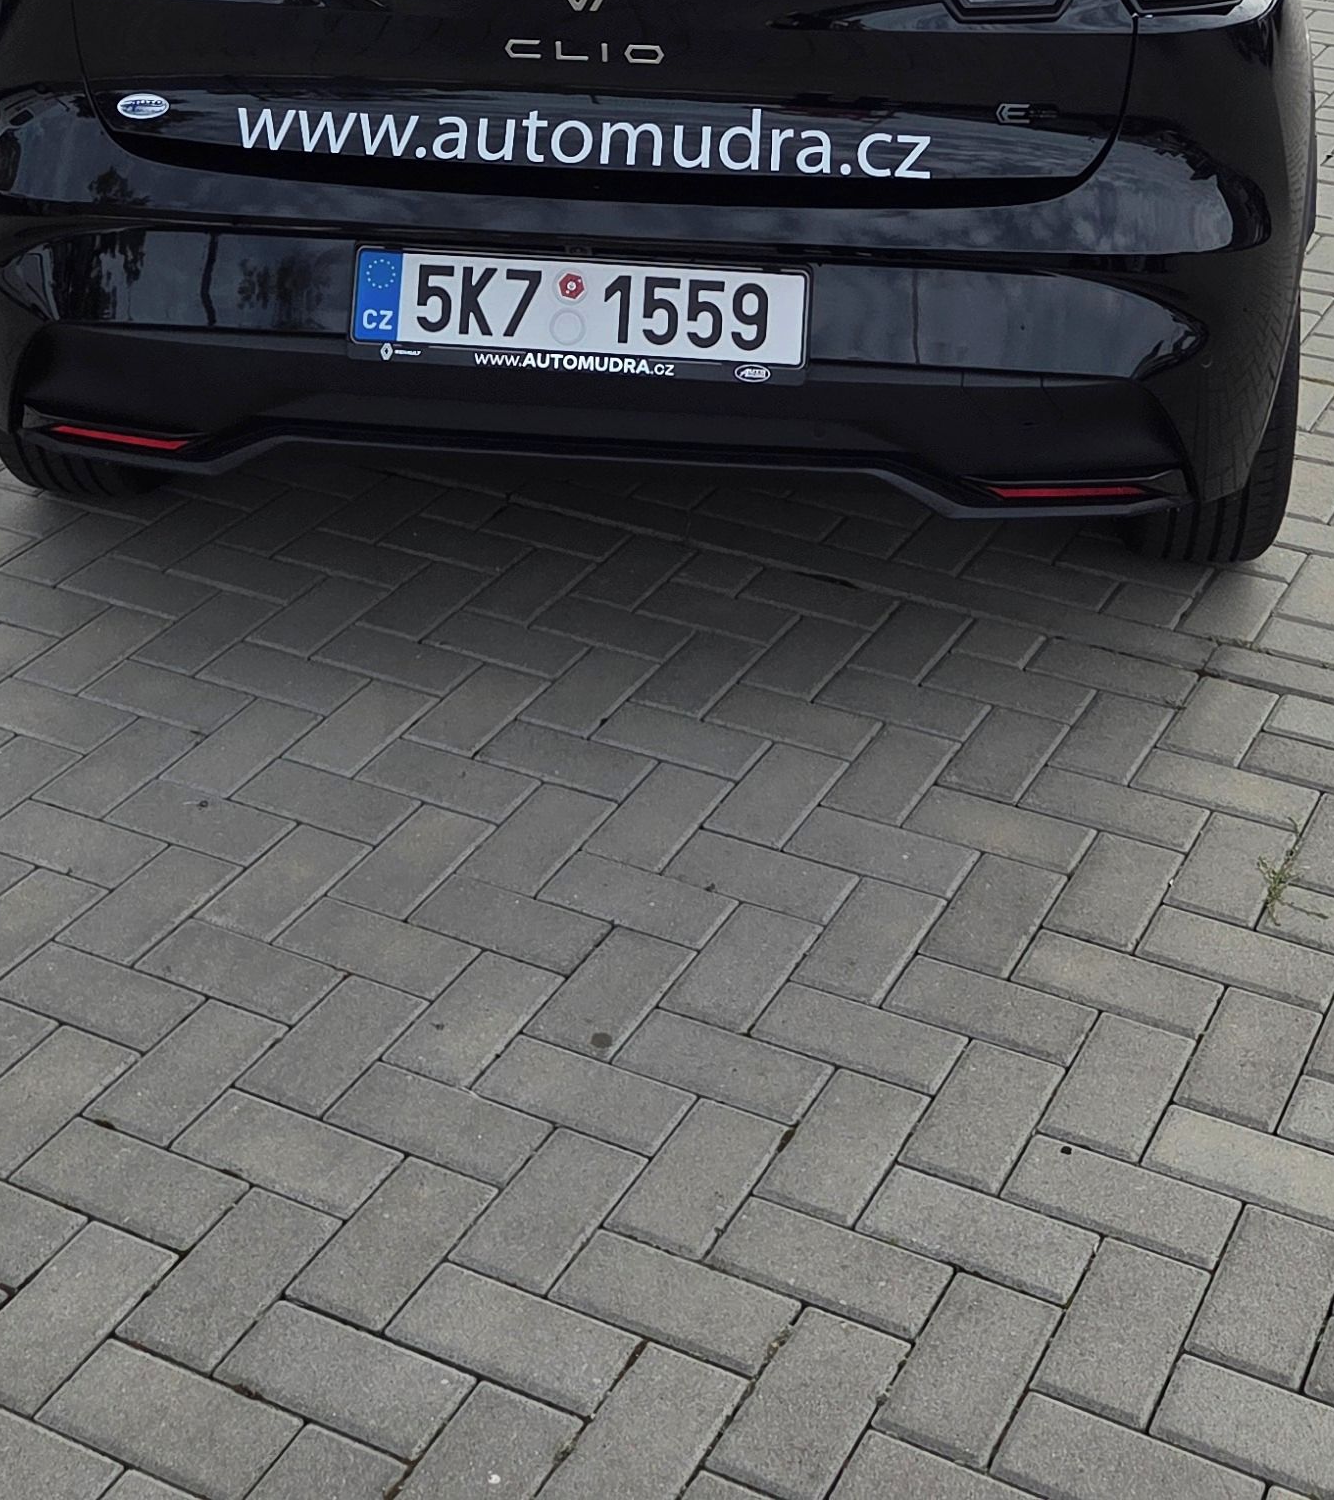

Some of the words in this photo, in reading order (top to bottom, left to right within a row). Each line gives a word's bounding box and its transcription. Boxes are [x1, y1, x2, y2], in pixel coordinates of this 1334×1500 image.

[504, 38, 665, 65] CLIO
[236, 106, 933, 180] www.automudra.cz
[362, 308, 394, 331] CZ
[415, 263, 544, 338] 5K7
[603, 274, 770, 352] 1559
